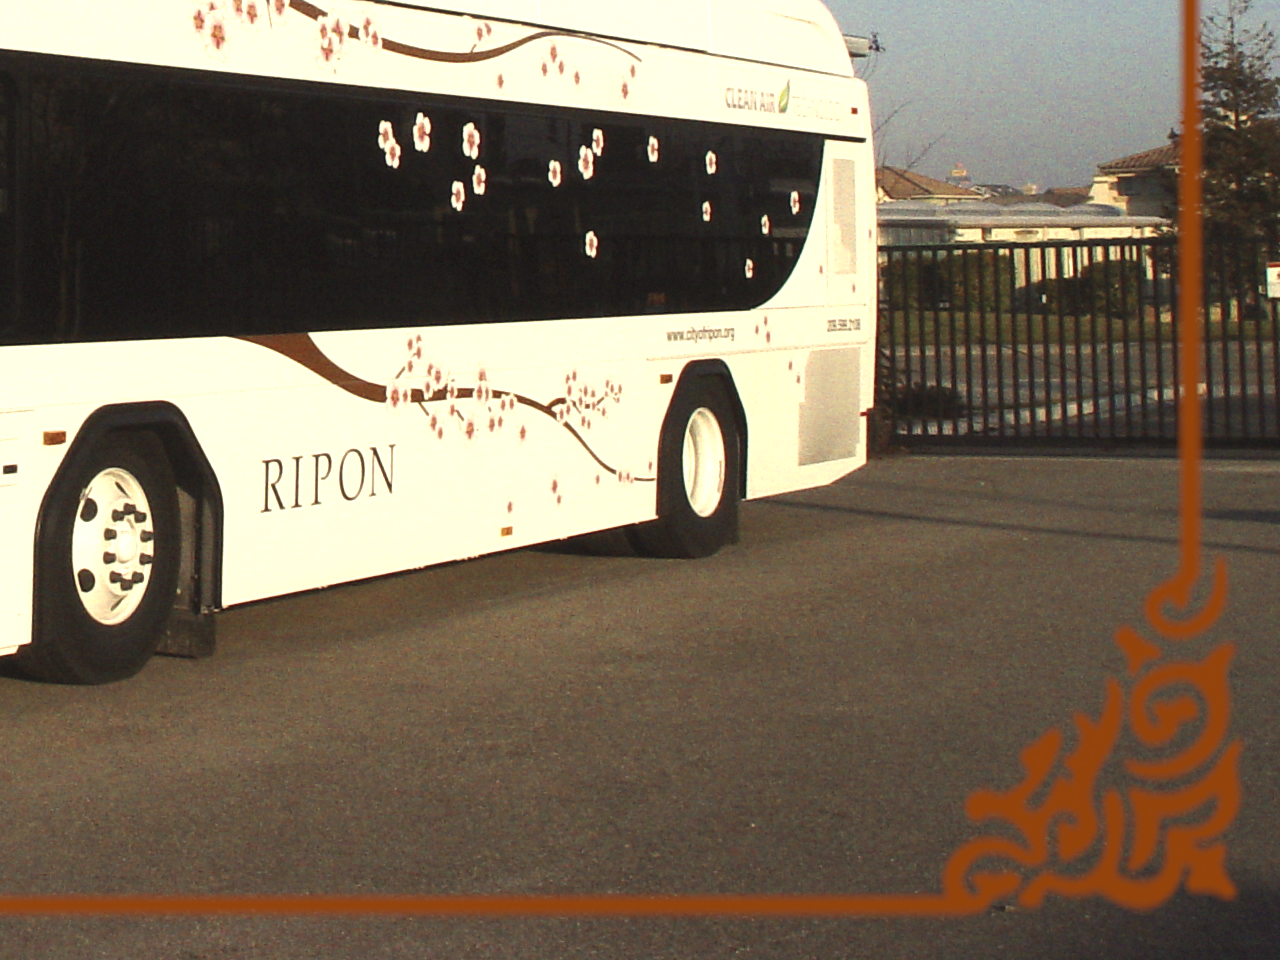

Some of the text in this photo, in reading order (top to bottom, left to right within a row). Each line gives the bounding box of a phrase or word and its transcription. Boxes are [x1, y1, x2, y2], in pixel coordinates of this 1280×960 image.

[725, 87, 758, 111] CLEAN
[759, 91, 776, 113] AIR
[260, 443, 396, 513] RIPON
